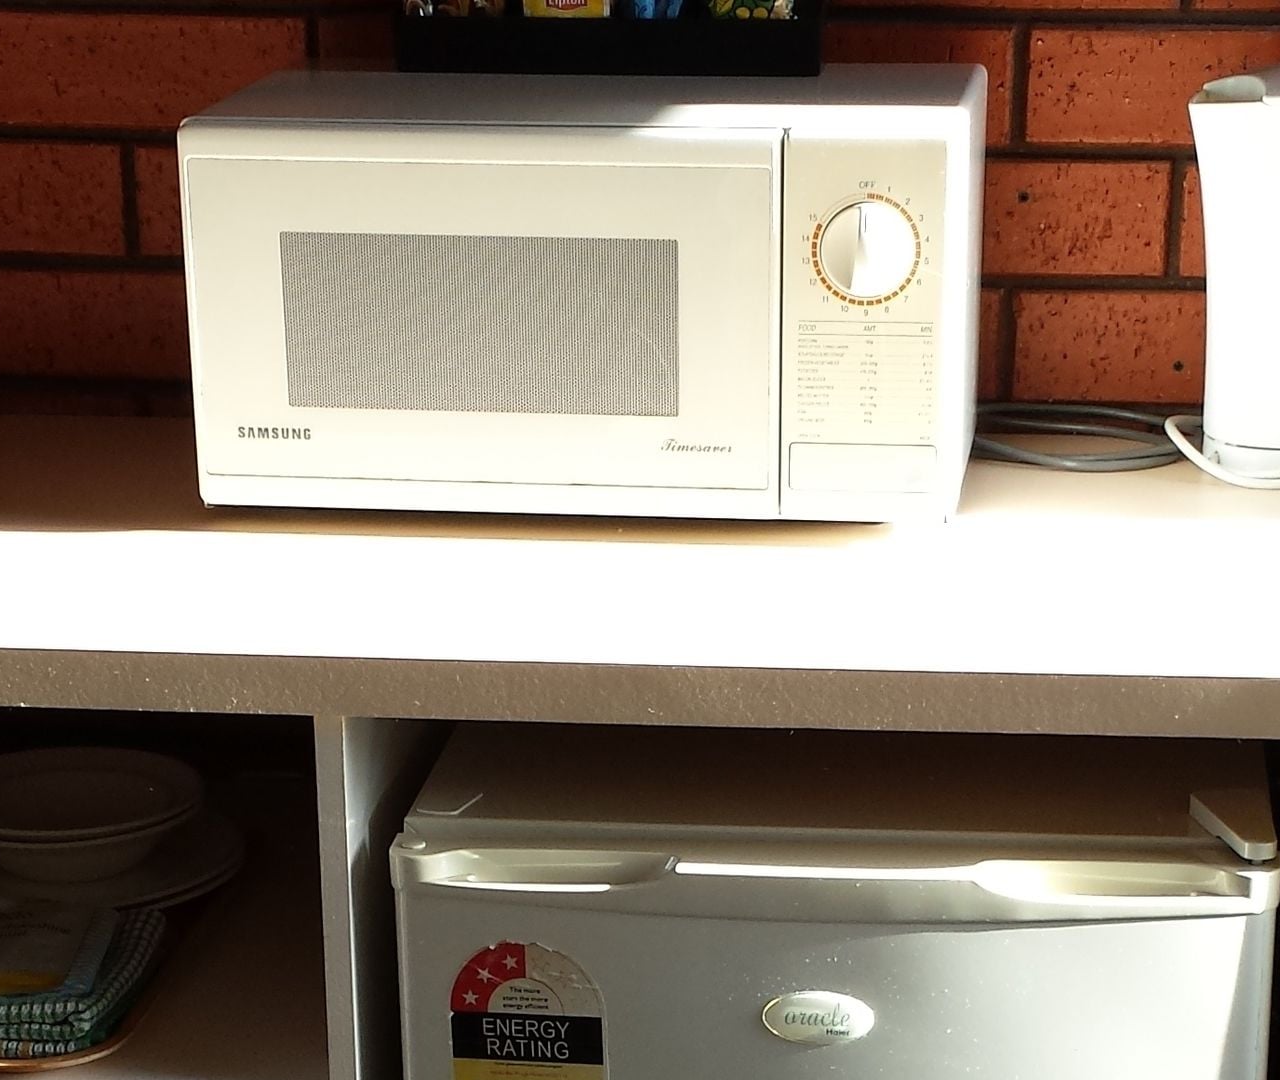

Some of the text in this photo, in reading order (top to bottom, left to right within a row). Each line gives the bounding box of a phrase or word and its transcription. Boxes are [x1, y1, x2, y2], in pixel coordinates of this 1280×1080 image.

[858, 181, 876, 189] OFF
[798, 324, 816, 332] FOOD
[238, 426, 311, 440] SAMSUNG
[660, 438, 732, 452] Timesaver
[784, 1002, 850, 1027] oracle
[482, 1018, 570, 1039] ENERGY
[826, 1028, 850, 1036] Haier
[487, 1038, 569, 1060] RATING
